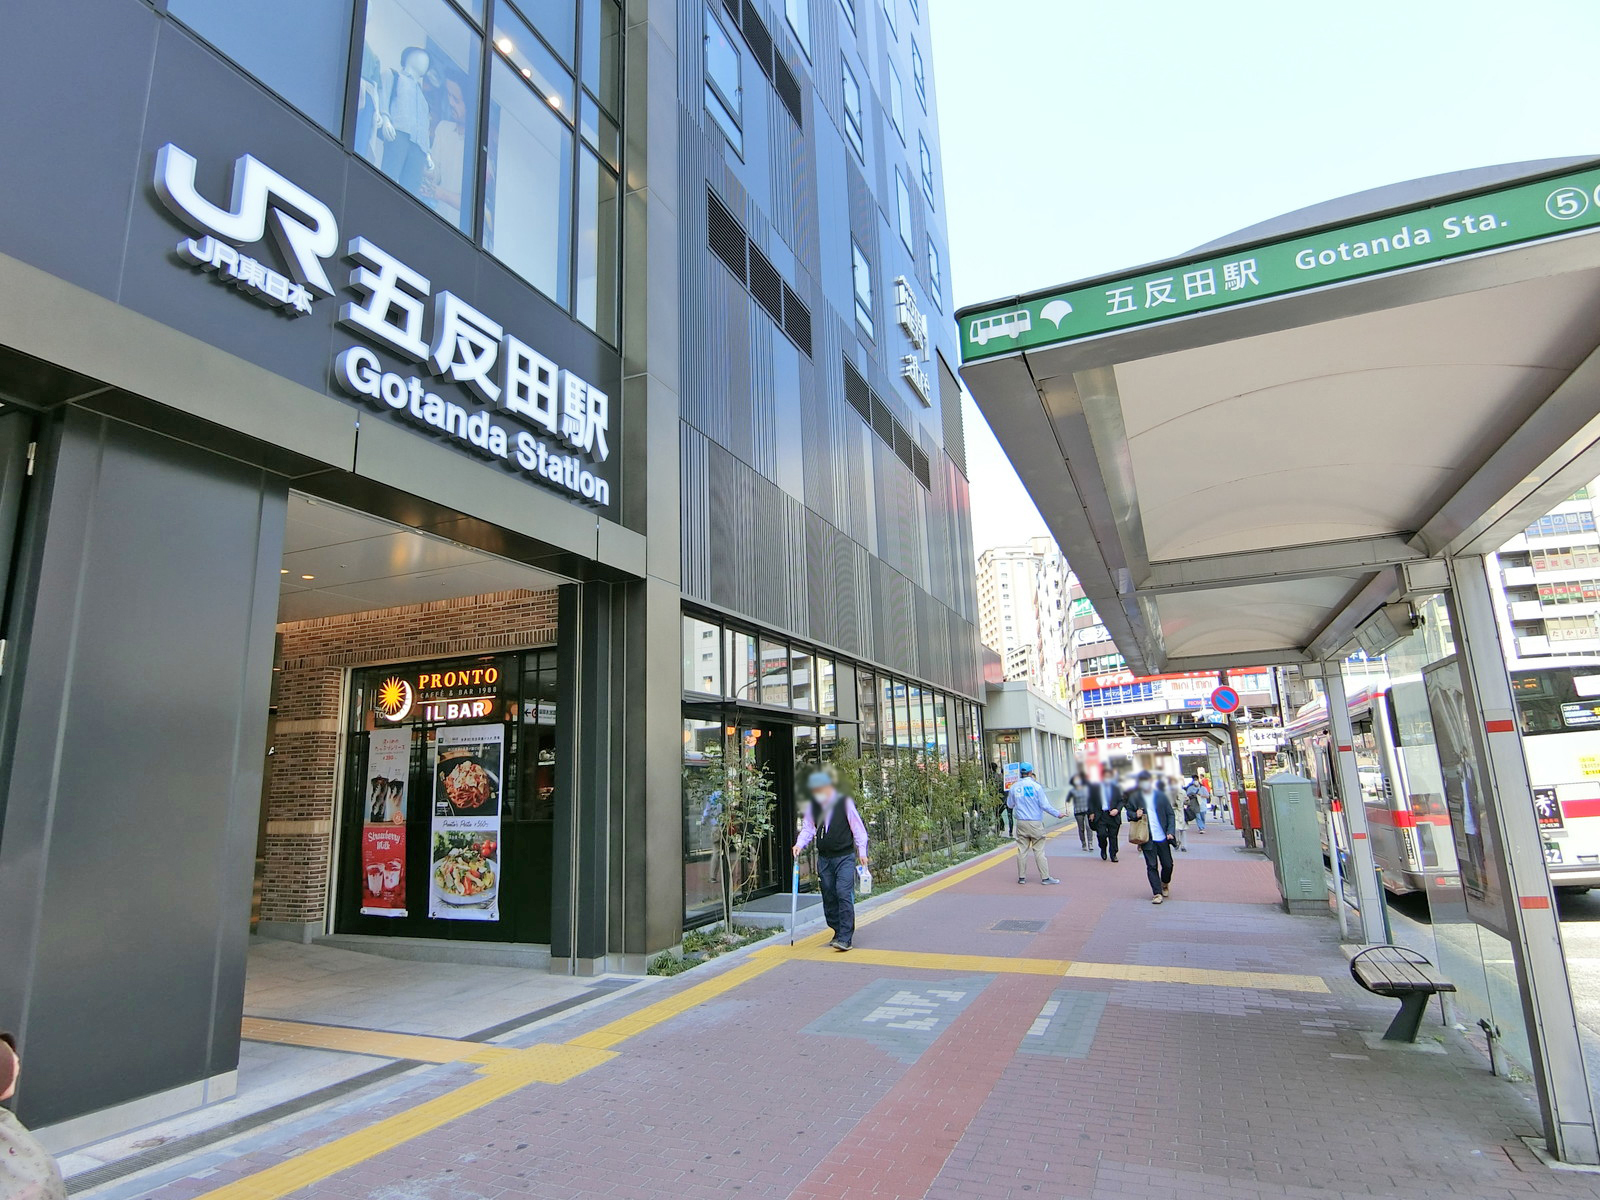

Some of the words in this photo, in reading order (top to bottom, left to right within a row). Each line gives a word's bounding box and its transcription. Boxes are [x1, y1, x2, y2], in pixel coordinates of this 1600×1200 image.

[180, 235, 314, 316] JR東日本
[1105, 257, 1261, 317] 五反田駅
[1295, 226, 1432, 270] Gotanda
[1443, 210, 1508, 238] Sta.
[340, 235, 610, 462] 五反田駅
[337, 346, 508, 460] Gotanda
[511, 430, 610, 507] Station
[418, 667, 498, 690] PRONTO
[447, 702, 485, 720] BAR
[478, 686, 498, 695] 1988
